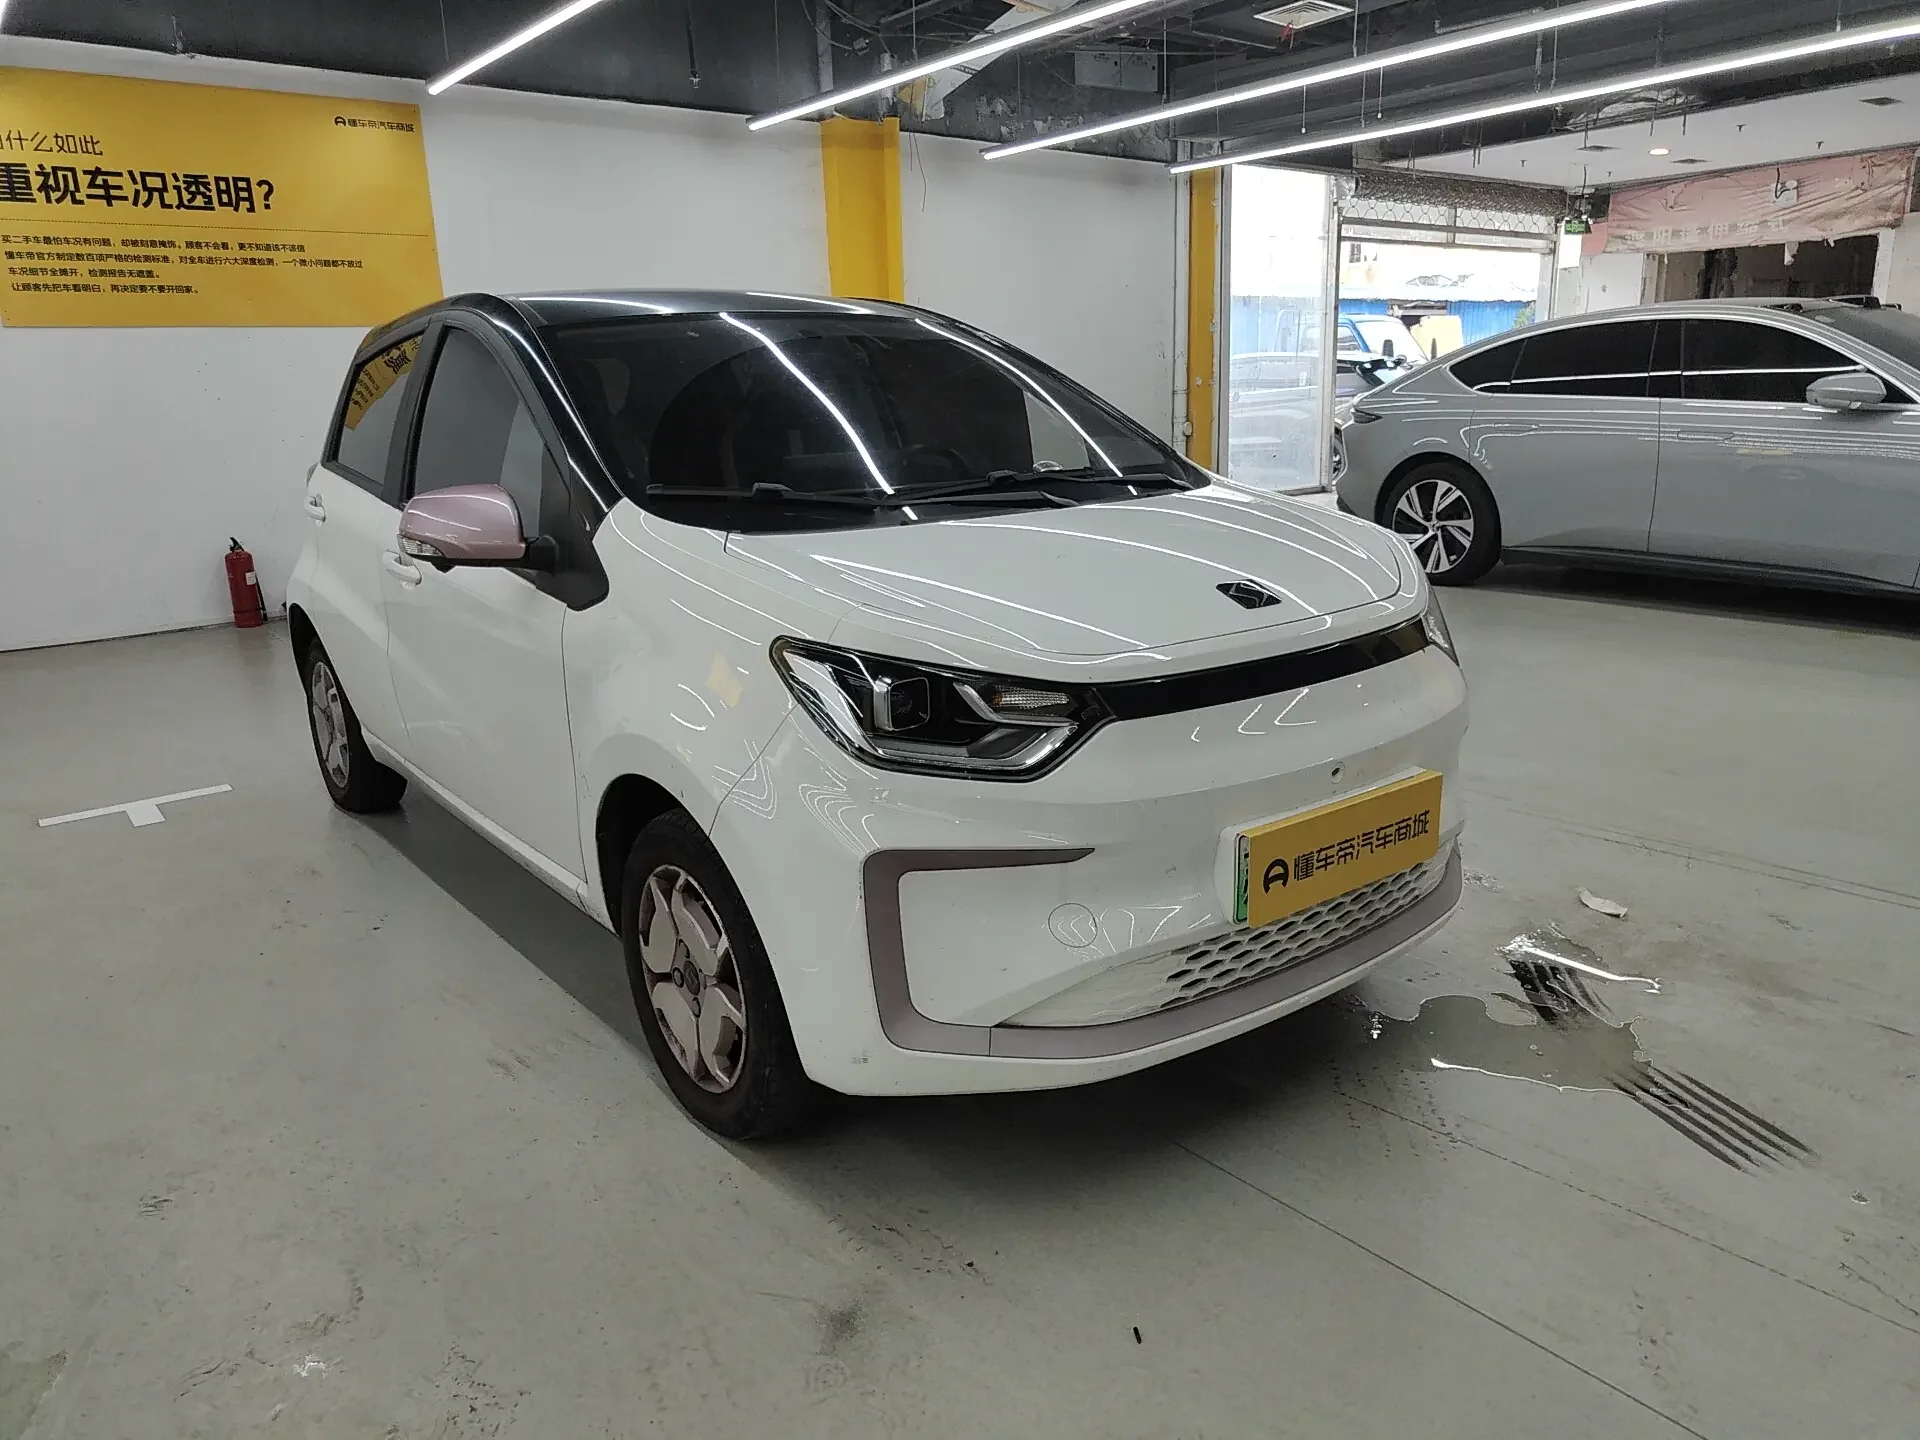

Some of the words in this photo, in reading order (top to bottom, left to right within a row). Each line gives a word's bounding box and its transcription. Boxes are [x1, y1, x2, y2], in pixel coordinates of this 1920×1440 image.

[1293, 809, 1430, 882] 懂车帝汽车商城
